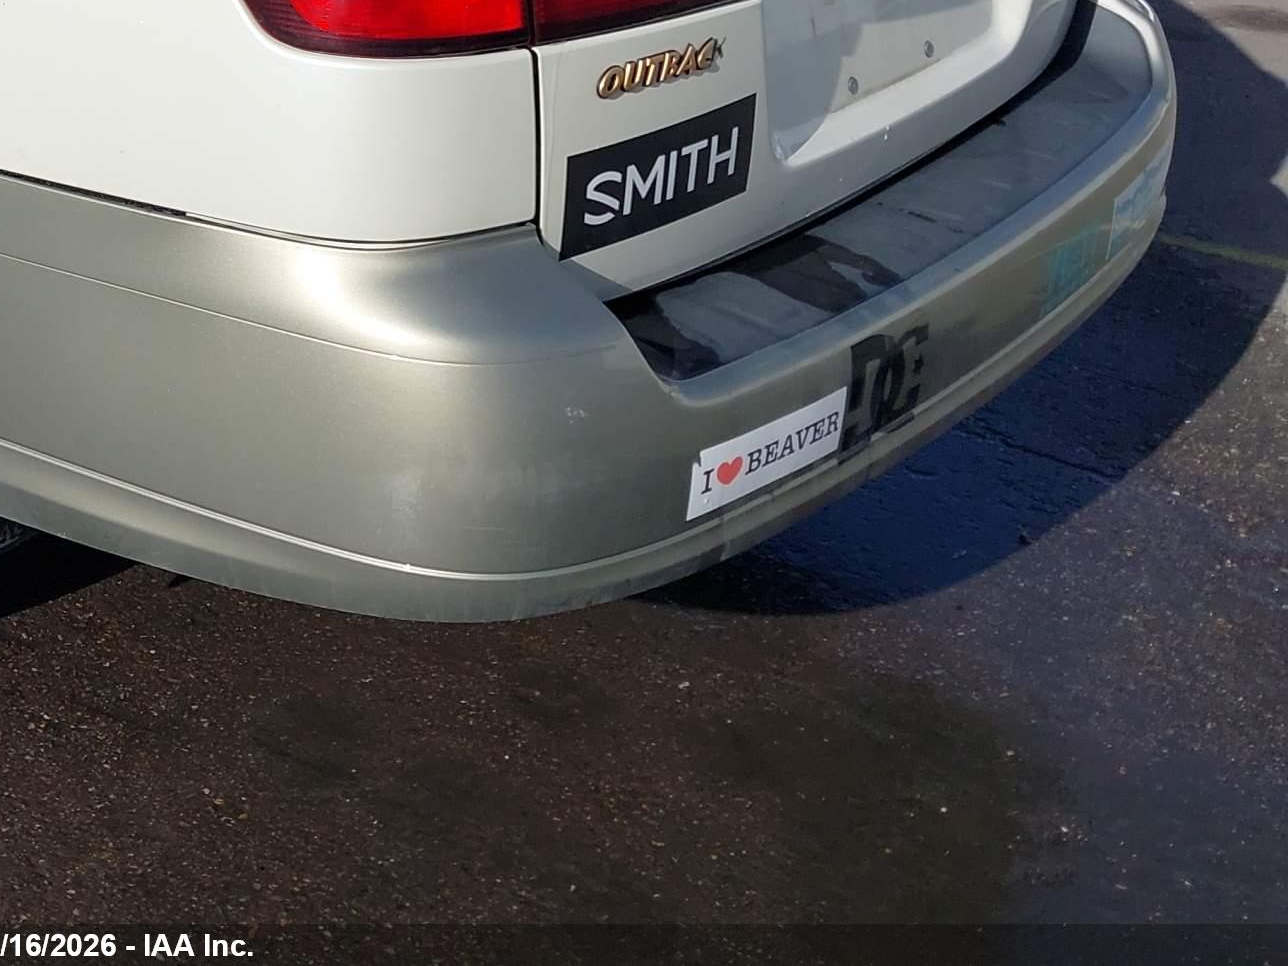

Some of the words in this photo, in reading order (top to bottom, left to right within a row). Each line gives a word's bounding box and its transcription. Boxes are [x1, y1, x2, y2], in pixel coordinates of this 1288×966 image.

[583, 125, 740, 226] SMITH
[701, 468, 716, 495] I
[744, 412, 840, 476] BEAVER
